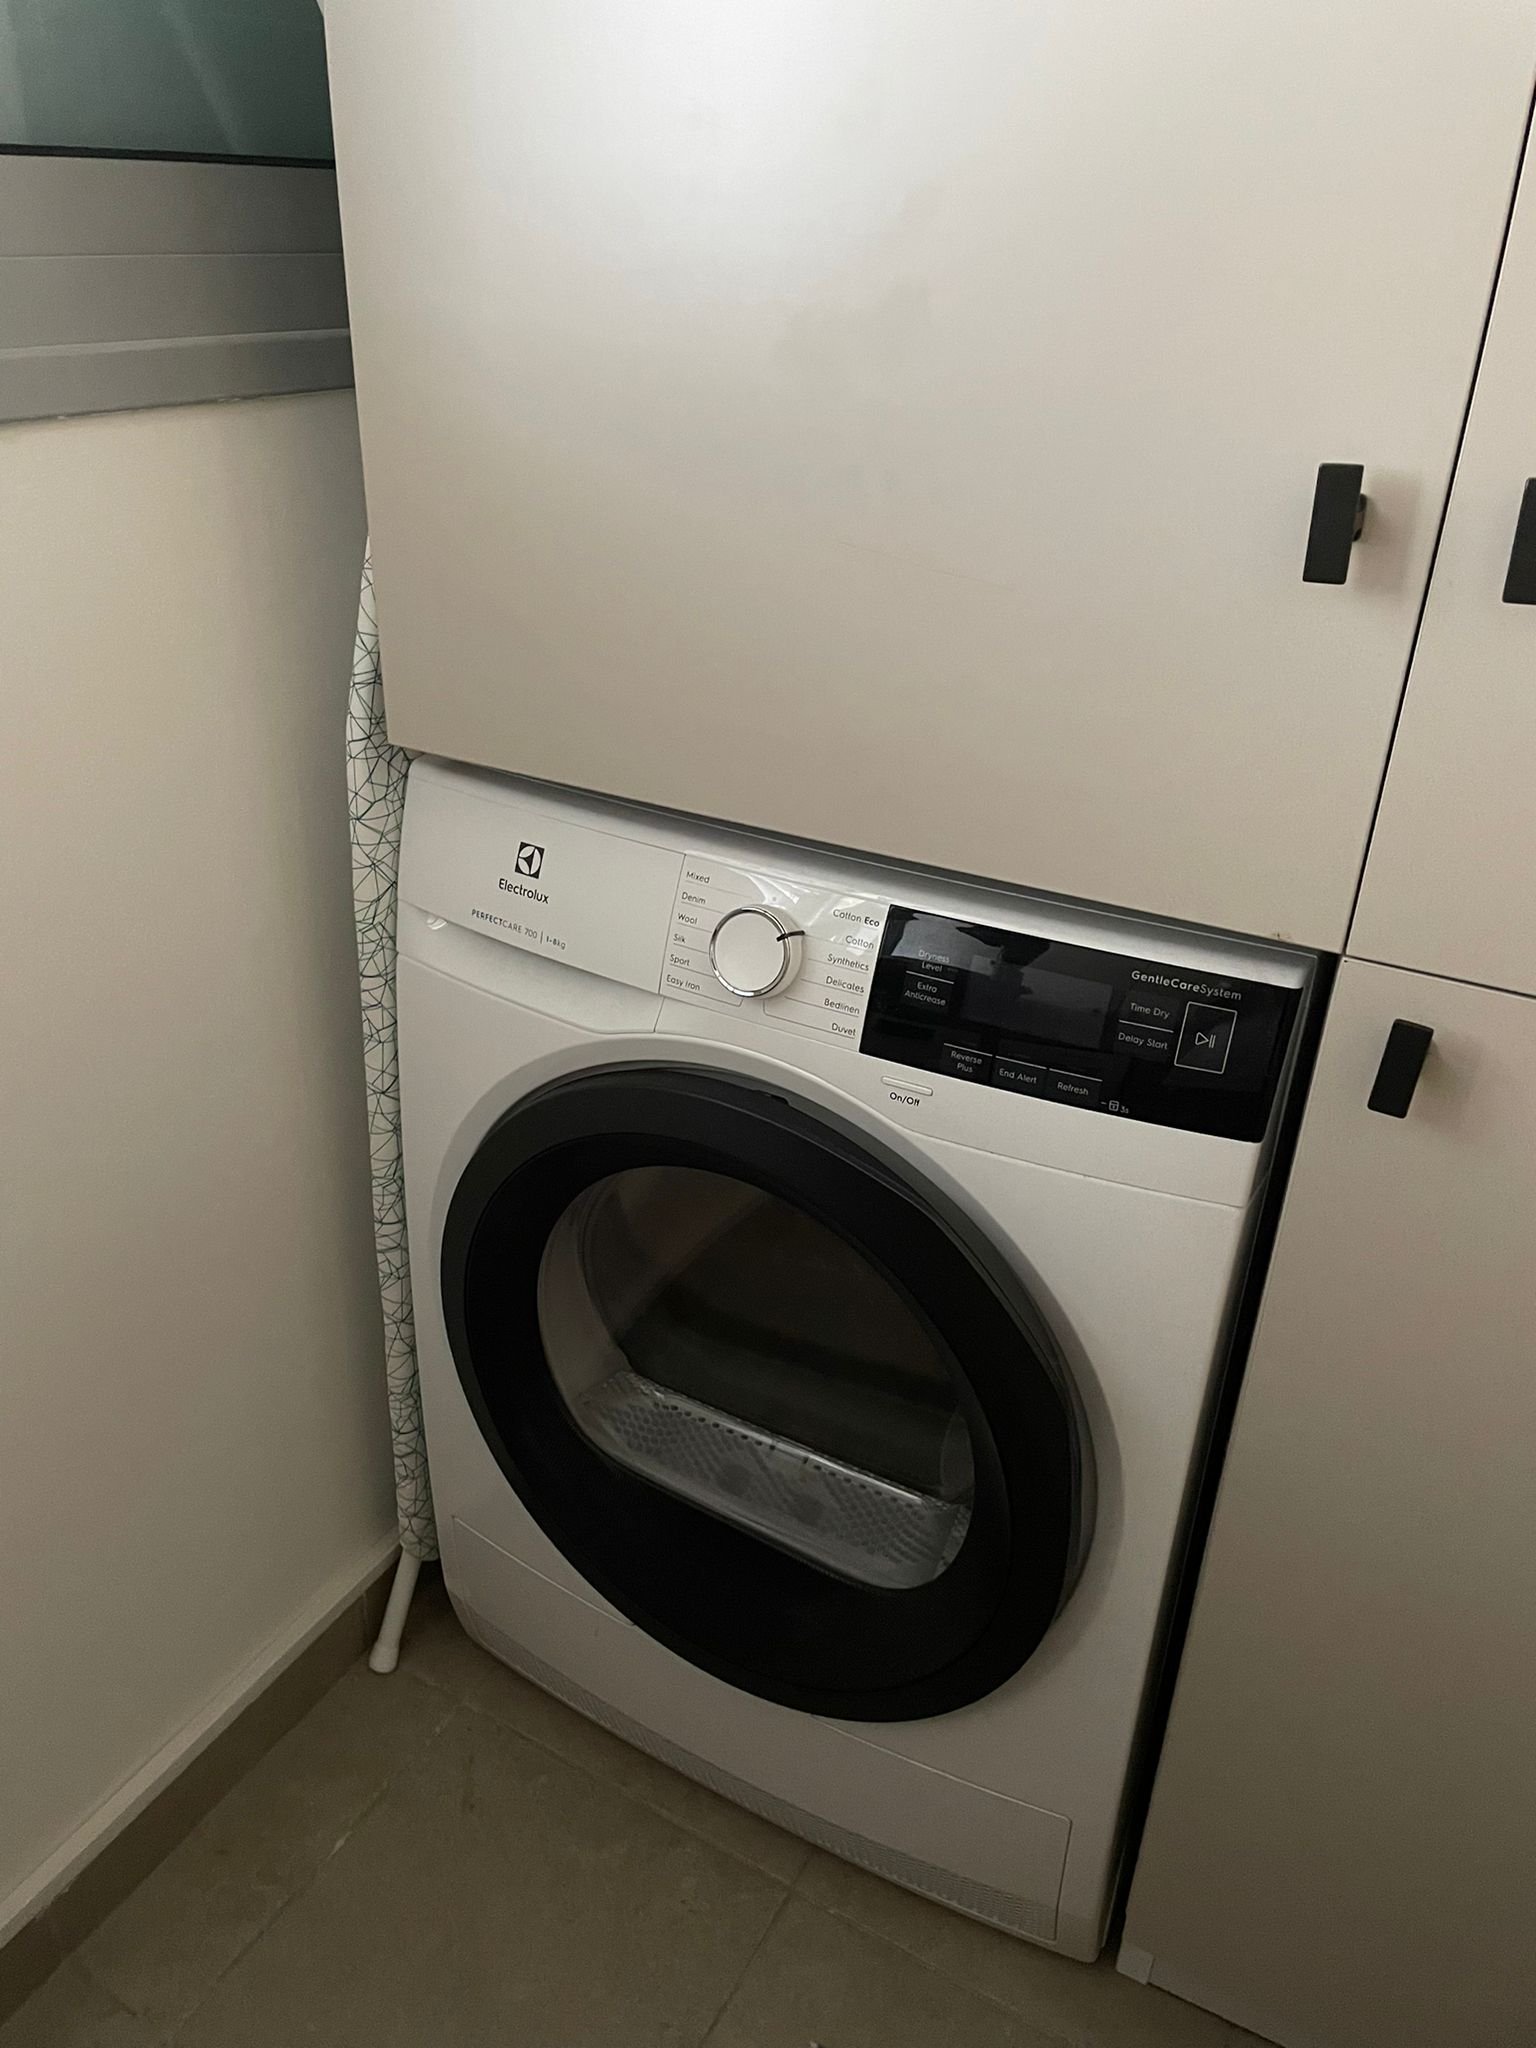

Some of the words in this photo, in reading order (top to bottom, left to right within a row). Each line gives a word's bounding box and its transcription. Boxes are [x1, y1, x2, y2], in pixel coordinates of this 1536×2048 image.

[686, 871, 709, 883] Mixed
[498, 878, 549, 904] Electrolux
[681, 892, 706, 905] Denim
[677, 912, 698, 925] Wool
[832, 909, 862, 923] Cotton
[864, 916, 880, 927] Eco
[471, 909, 522, 933] PERFECTCARE
[524, 929, 538, 940] 700
[546, 935, 566, 950] 1-8kg
[673, 933, 686, 944] Silk
[845, 935, 874, 950] Cotton
[669, 954, 690, 967] Sport
[827, 953, 869, 971] Synthetics
[918, 949, 950, 964] Dryness
[922, 961, 943, 973] Level
[666, 974, 683, 988] Easy
[683, 979, 700, 991] Iron
[826, 976, 864, 993] Delicates
[917, 983, 937, 994] Extra
[1131, 970, 1242, 1000] GentleCareSystem
[904, 990, 946, 1007] Anticrease
[824, 998, 860, 1015] Bedlinen
[1129, 1002, 1150, 1016] Time
[1151, 1007, 1170, 1020] Dry
[831, 1023, 856, 1036] Duvet
[1118, 1032, 1143, 1047] Delay
[1146, 1038, 1168, 1050] Start
[951, 1050, 982, 1065] Reverse
[957, 1061, 973, 1073] Plus
[999, 1068, 1015, 1079] End
[1016, 1072, 1037, 1085] Alert
[1057, 1082, 1089, 1097] Refresh
[889, 1092, 920, 1107] On/Off
[1120, 1104, 1129, 1114] 3s
